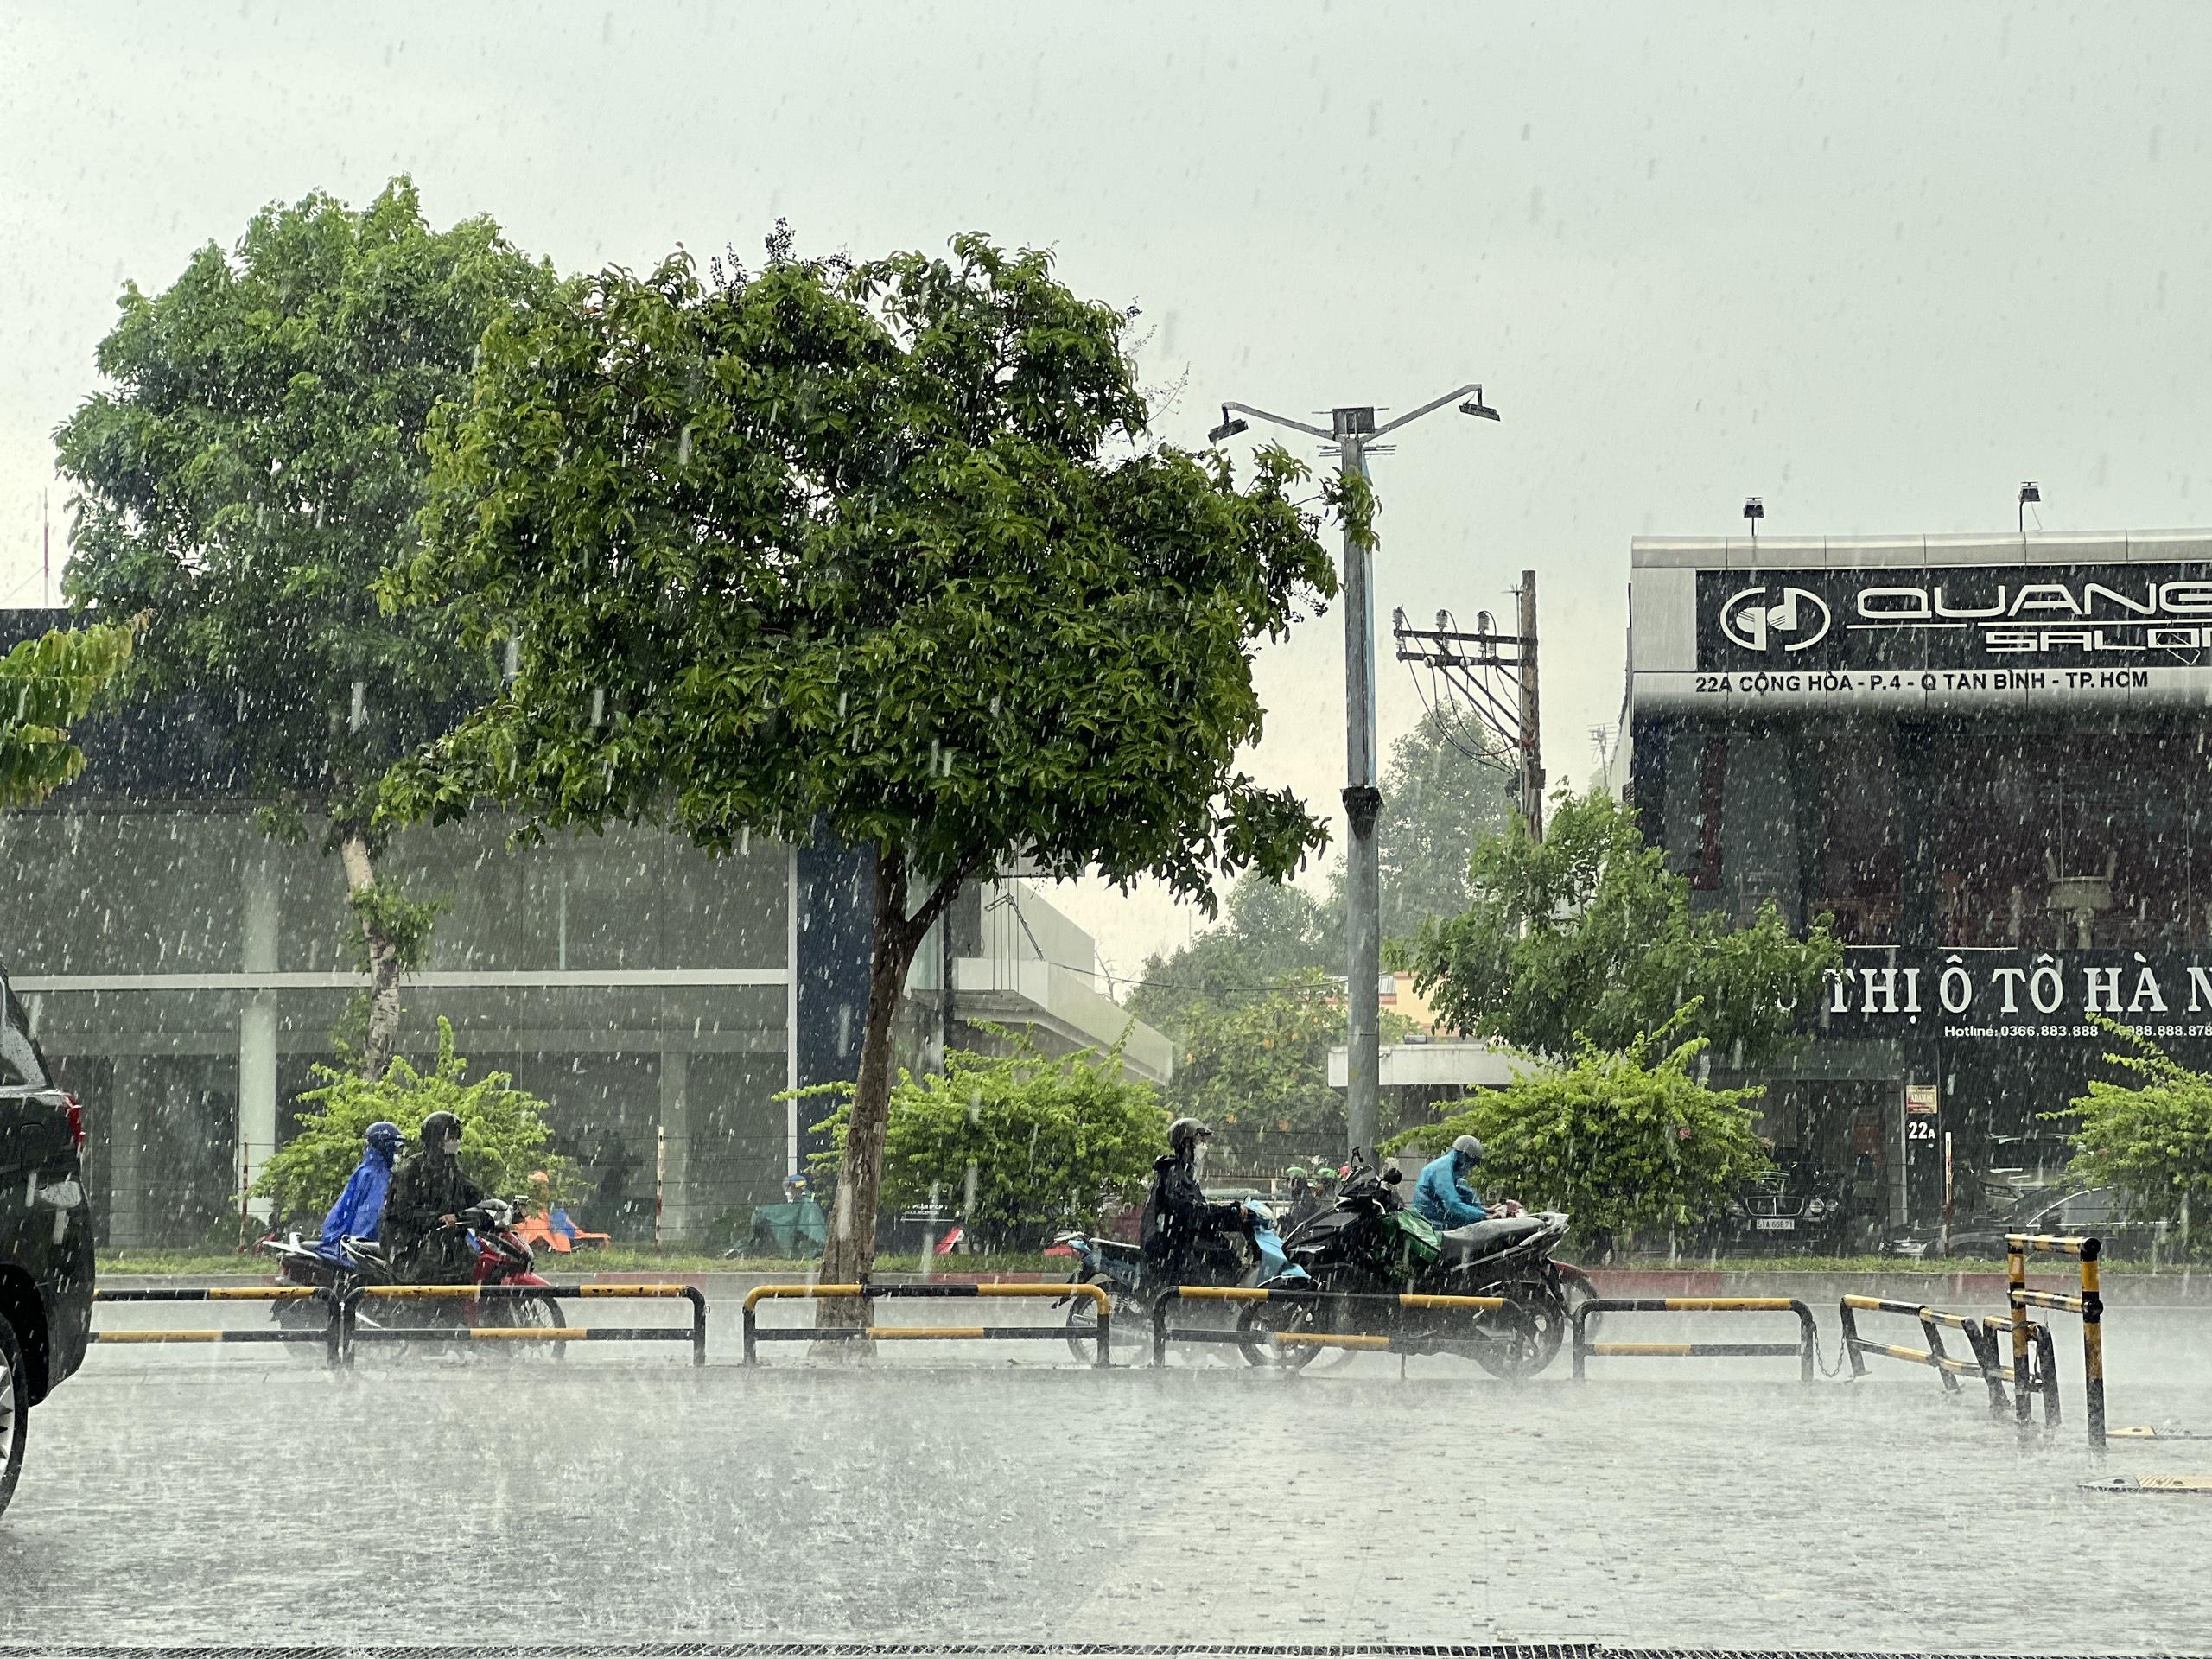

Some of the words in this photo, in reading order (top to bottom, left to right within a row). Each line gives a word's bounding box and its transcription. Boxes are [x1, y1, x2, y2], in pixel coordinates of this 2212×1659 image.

[1857, 581, 2212, 619] QUANG
[1986, 628, 2212, 652] SALO
[1695, 676, 1732, 692] 22A
[1739, 671, 1800, 696] CỘNG
[1808, 671, 1853, 691] HÒA
[1994, 669, 2045, 689] BÌNH
[1939, 954, 1973, 1014] Ô
[1991, 952, 2063, 1014] TÔ
[2082, 951, 2168, 1013] HÀ
[1944, 1026, 1999, 1037] Hotline:
[2000, 1025, 2099, 1037] 0366.883.888
[2119, 1025, 2212, 1037] 88.888.878
[1908, 1122, 1936, 1139] 22A
